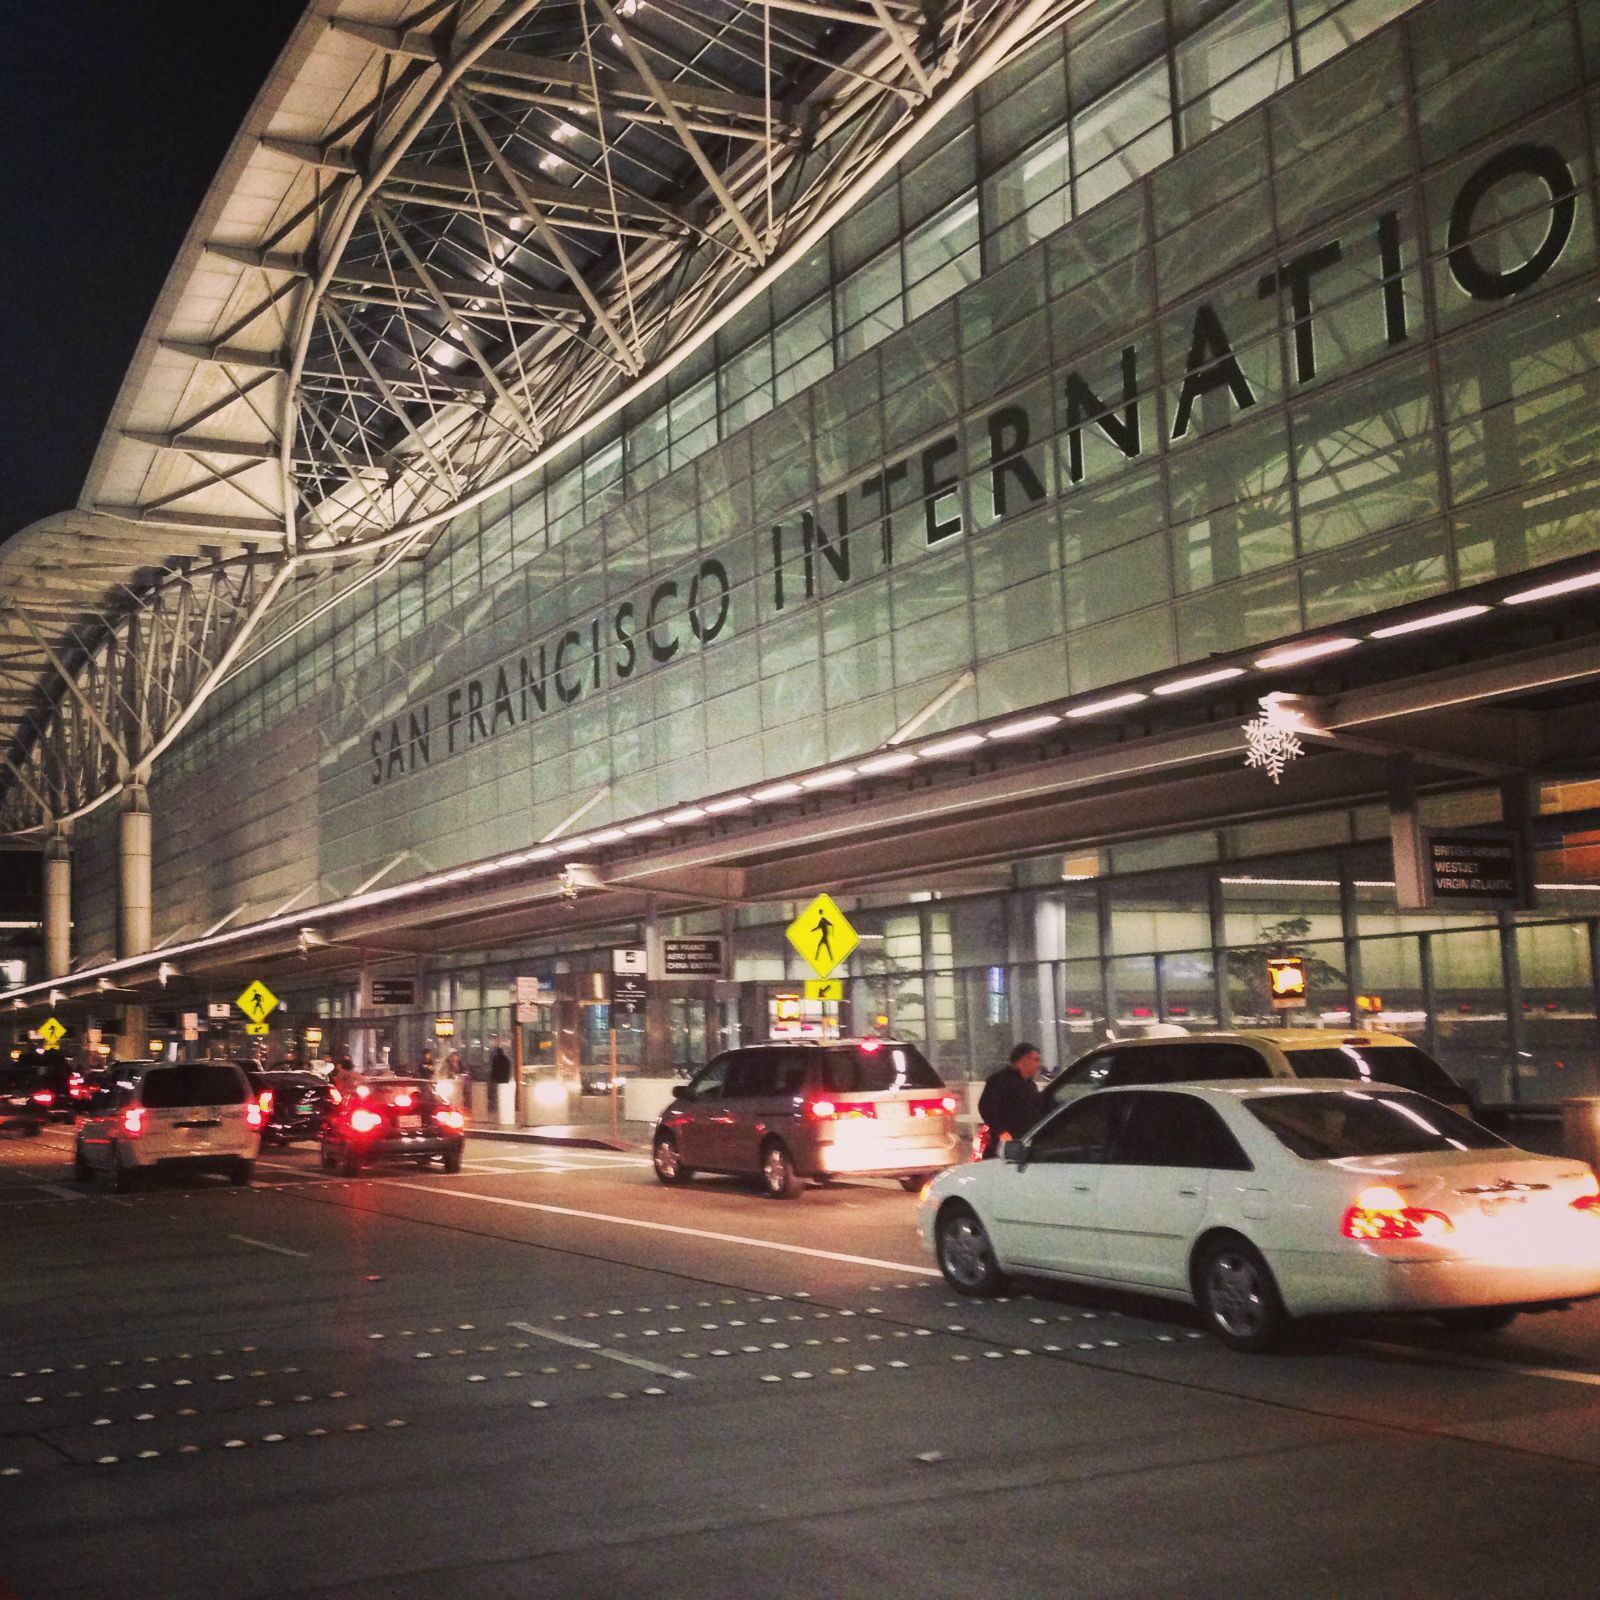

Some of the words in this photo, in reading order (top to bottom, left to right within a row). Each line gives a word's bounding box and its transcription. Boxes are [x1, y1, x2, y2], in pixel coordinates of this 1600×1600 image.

[370, 705, 431, 786] SAN
[447, 558, 730, 754] FRANCISCO
[771, 141, 1577, 612] INTERNATIO
[1433, 845, 1471, 857] BRITISH
[1434, 862, 1479, 873] WESTJET
[1436, 878, 1469, 889] VIRGIN
[1470, 879, 1513, 890] ATLANTIC
